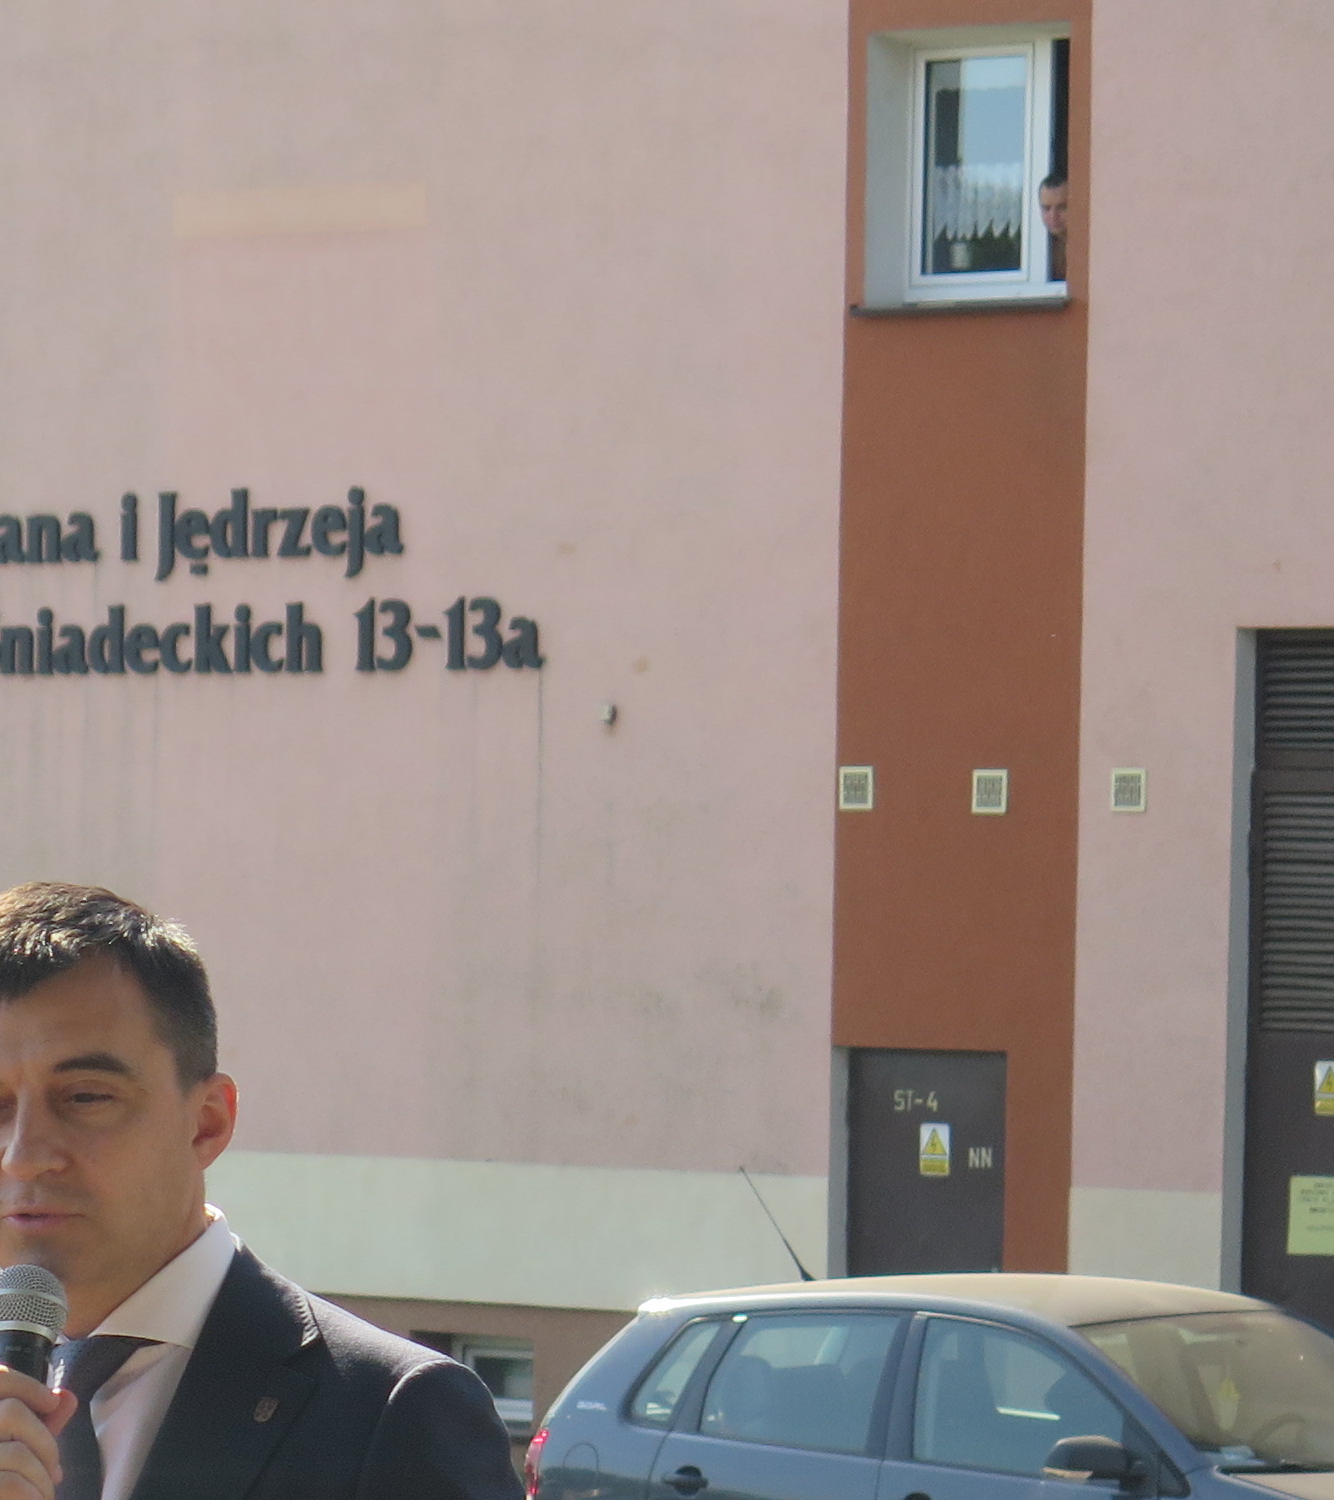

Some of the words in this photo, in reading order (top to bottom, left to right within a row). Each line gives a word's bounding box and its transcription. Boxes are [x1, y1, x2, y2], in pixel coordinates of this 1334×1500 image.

[120, 491, 139, 563] i
[155, 486, 403, 582] Jędrzeja
[354, 595, 545, 675] 13-13a
[893, 1089, 939, 1113] ST-4
[968, 1147, 993, 1169] NN
